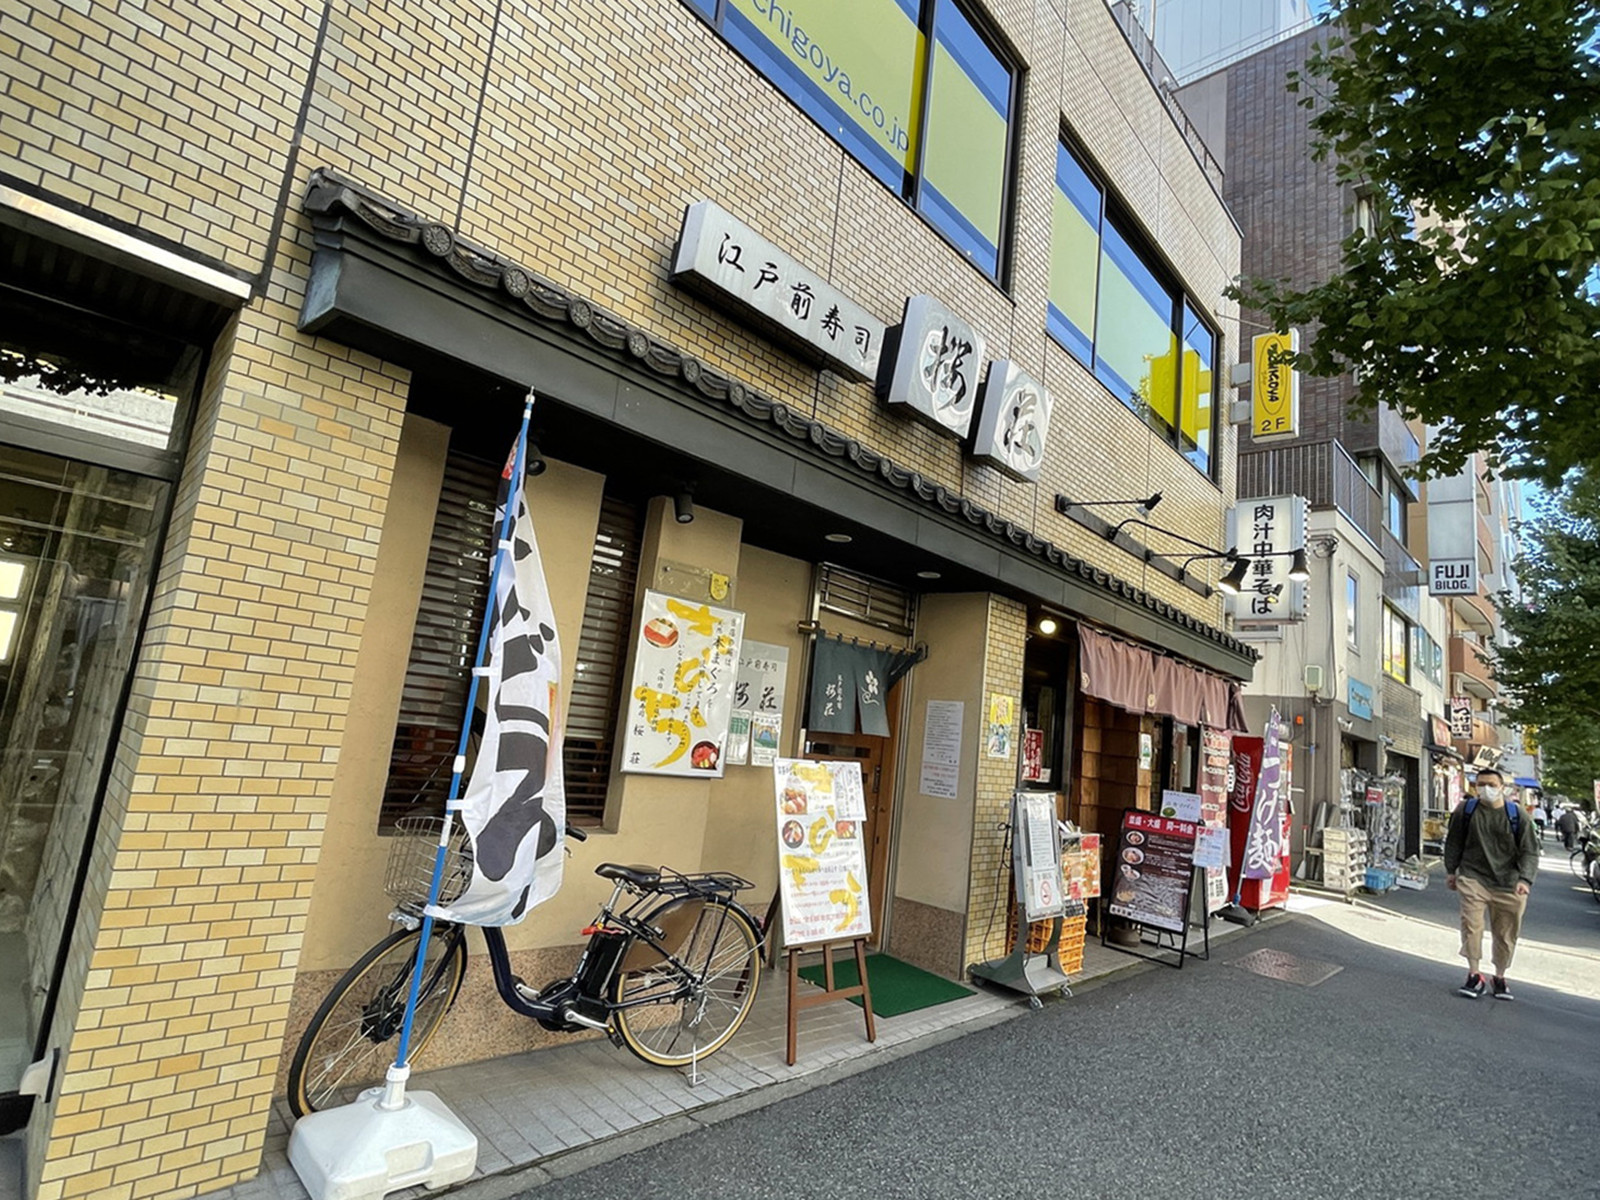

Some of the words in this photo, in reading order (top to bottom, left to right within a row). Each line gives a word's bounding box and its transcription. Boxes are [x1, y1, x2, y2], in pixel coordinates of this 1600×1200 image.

[717, 233, 871, 360] 江戸前寿司
[1261, 417, 1286, 432] 2F
[1250, 504, 1276, 615] 肉汁中華そば
[1435, 564, 1470, 579] FUJI
